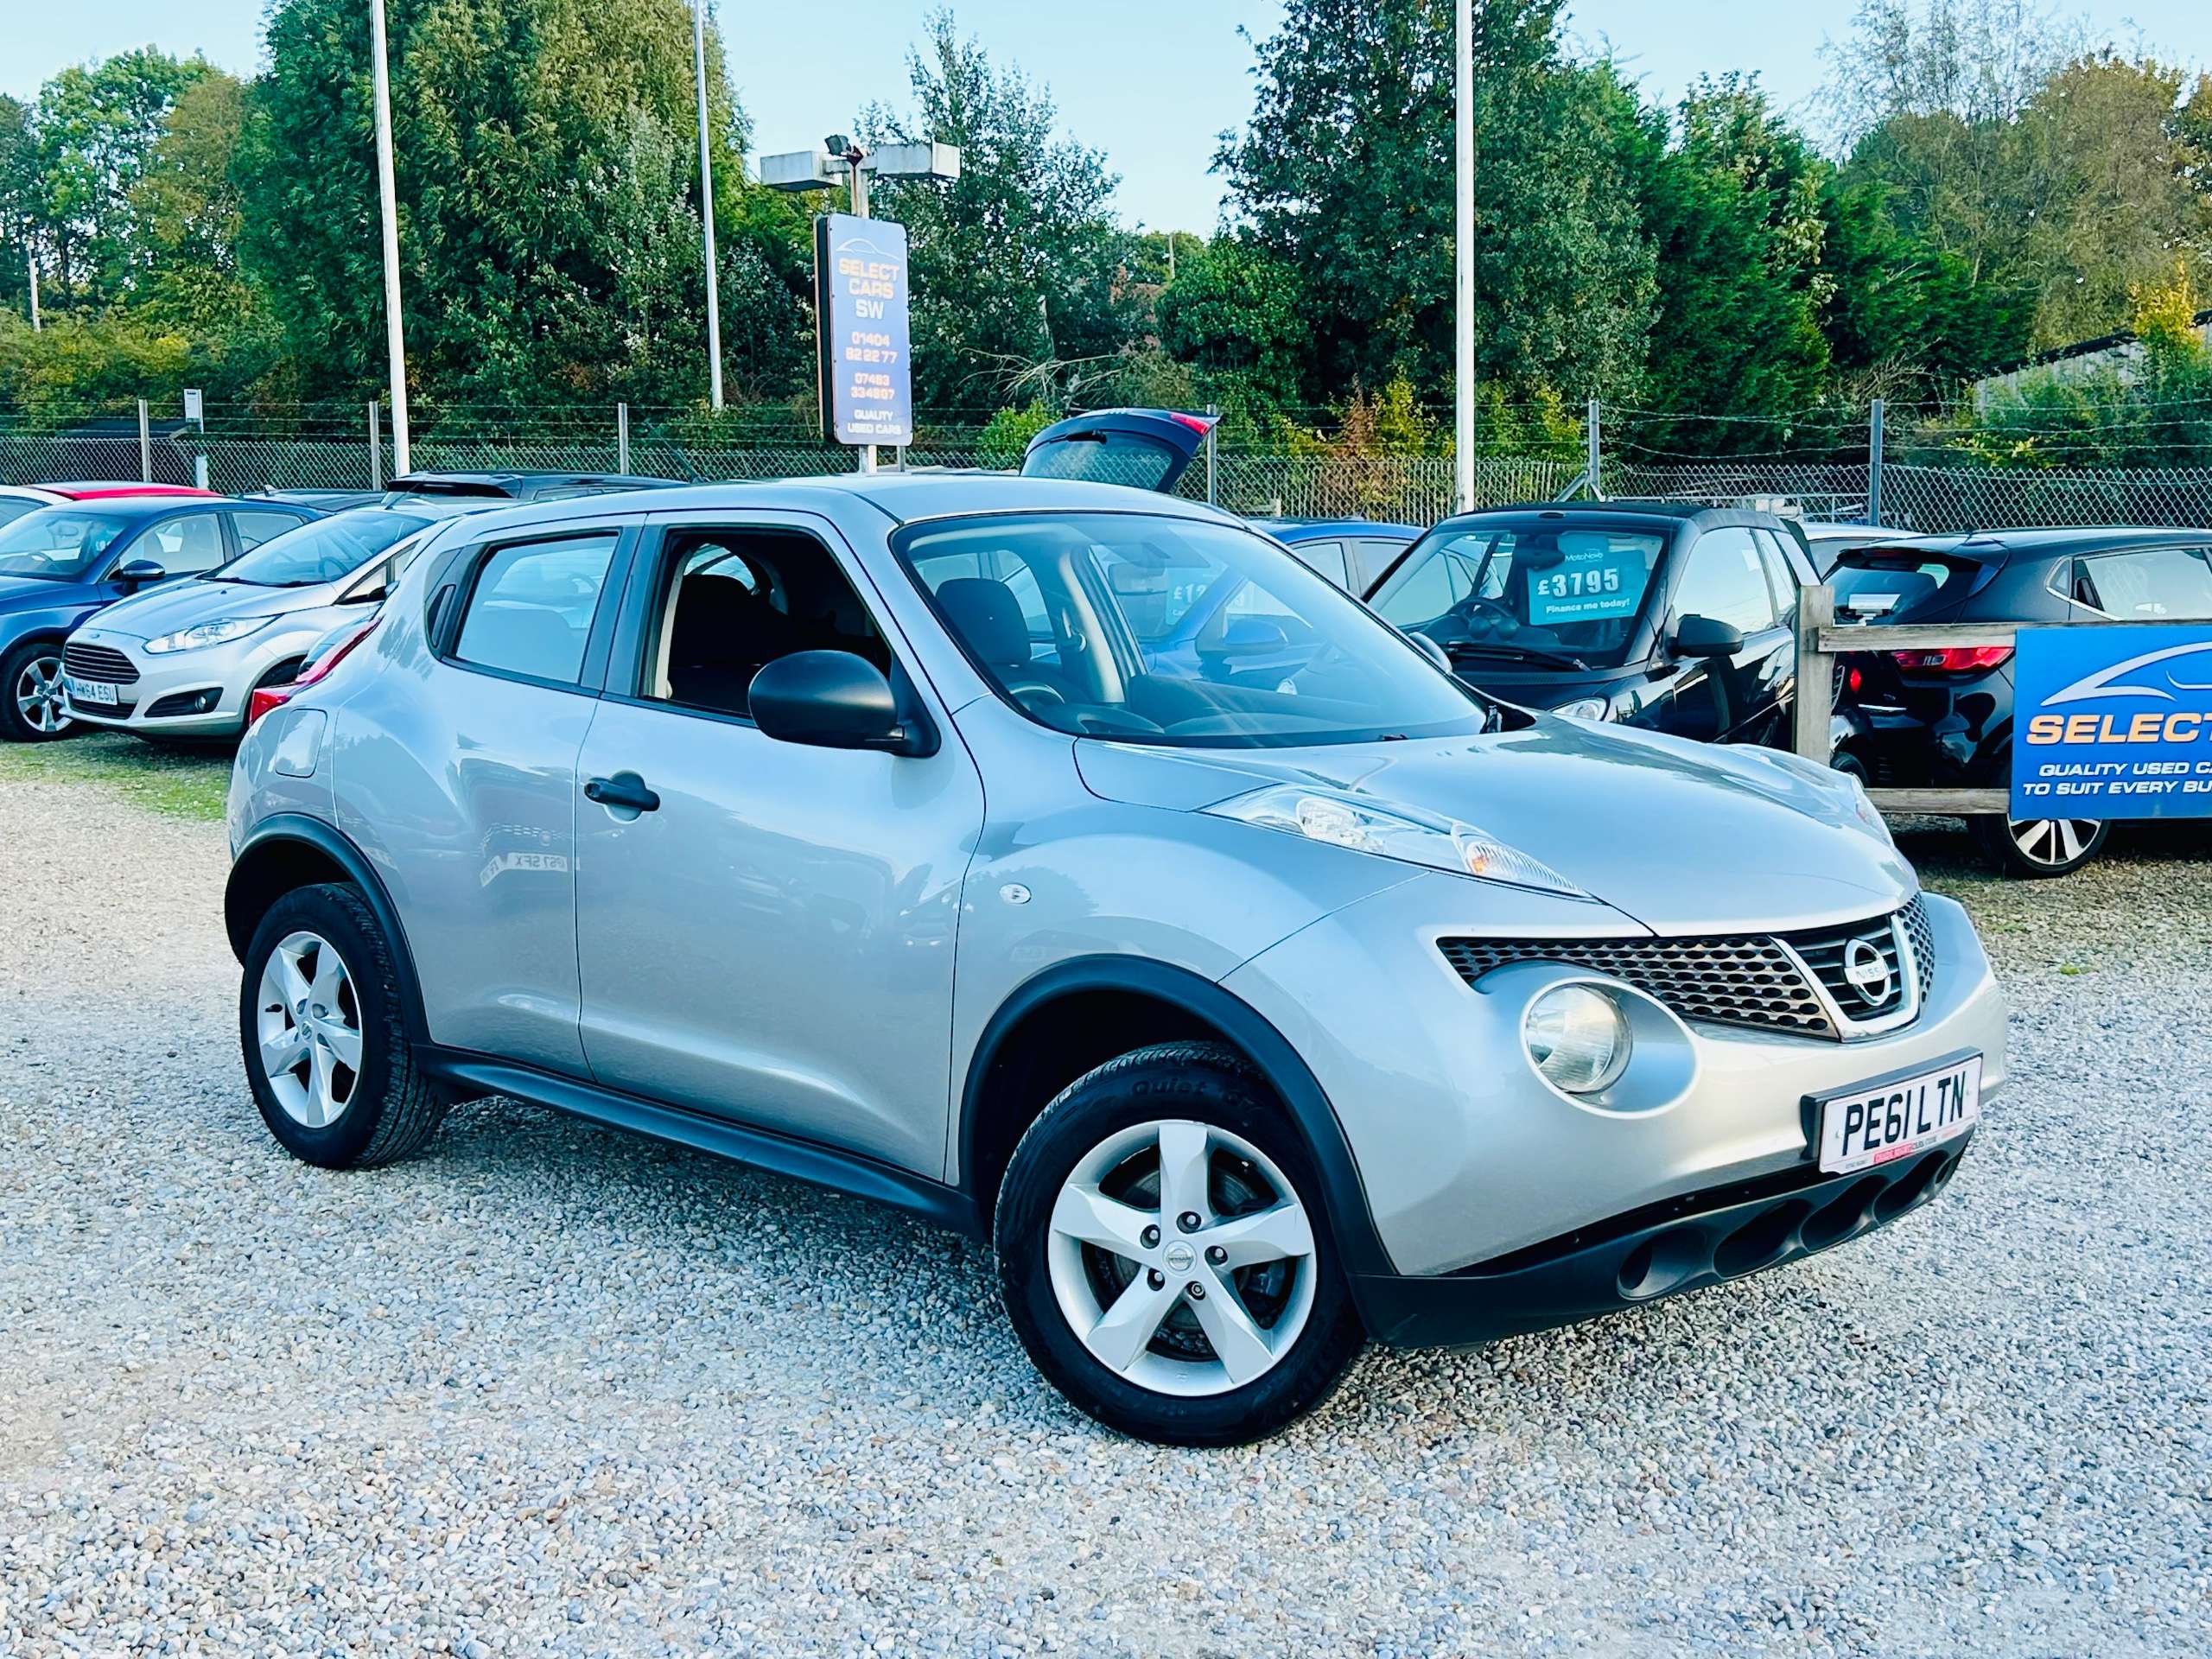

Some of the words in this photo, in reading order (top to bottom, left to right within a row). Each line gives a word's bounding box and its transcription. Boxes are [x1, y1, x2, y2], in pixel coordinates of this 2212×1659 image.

[839, 257, 899, 282] SELECT
[849, 277, 893, 300] CARS
[855, 298, 884, 320] SW
[852, 331, 890, 347] 01404
[854, 409, 893, 422] QUALITY
[848, 423, 874, 434] USED
[875, 424, 903, 435] CARS
[1537, 568, 1619, 597] £3795
[1546, 603, 1582, 614] Finance
[1599, 598, 1630, 609] today!
[2026, 713, 2212, 745] SELEC
[2038, 763, 2127, 777] QUALITY
[2132, 762, 2190, 776] USED
[2023, 783, 2051, 796] TO
[2056, 781, 2105, 795] SUIT
[2107, 780, 2179, 794] EVERY
